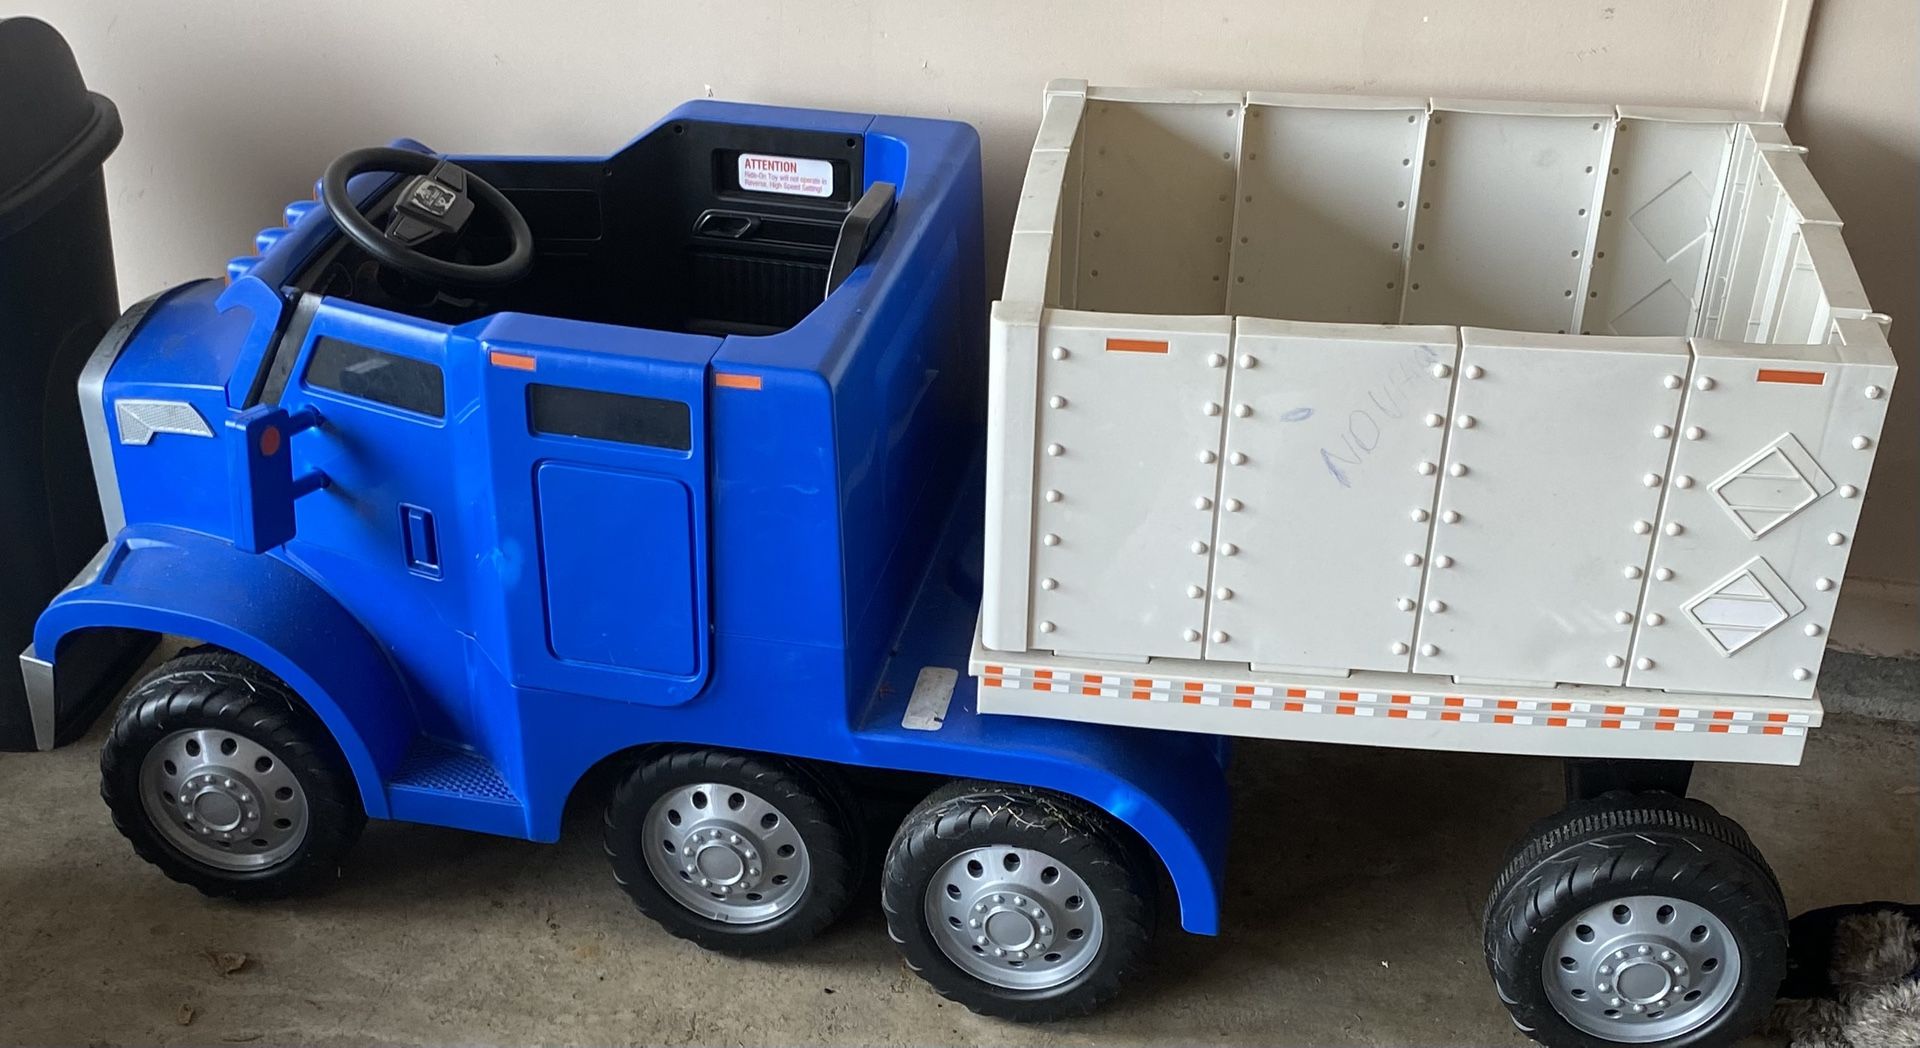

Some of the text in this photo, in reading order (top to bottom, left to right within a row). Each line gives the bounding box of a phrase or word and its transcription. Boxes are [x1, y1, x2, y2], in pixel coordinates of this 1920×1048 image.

[745, 158, 797, 173] ATTENTION
[768, 173, 778, 182] Toy
[779, 174, 789, 182] will
[800, 177, 820, 185] operate
[769, 181, 783, 190] High
[784, 182, 801, 191] Speed
